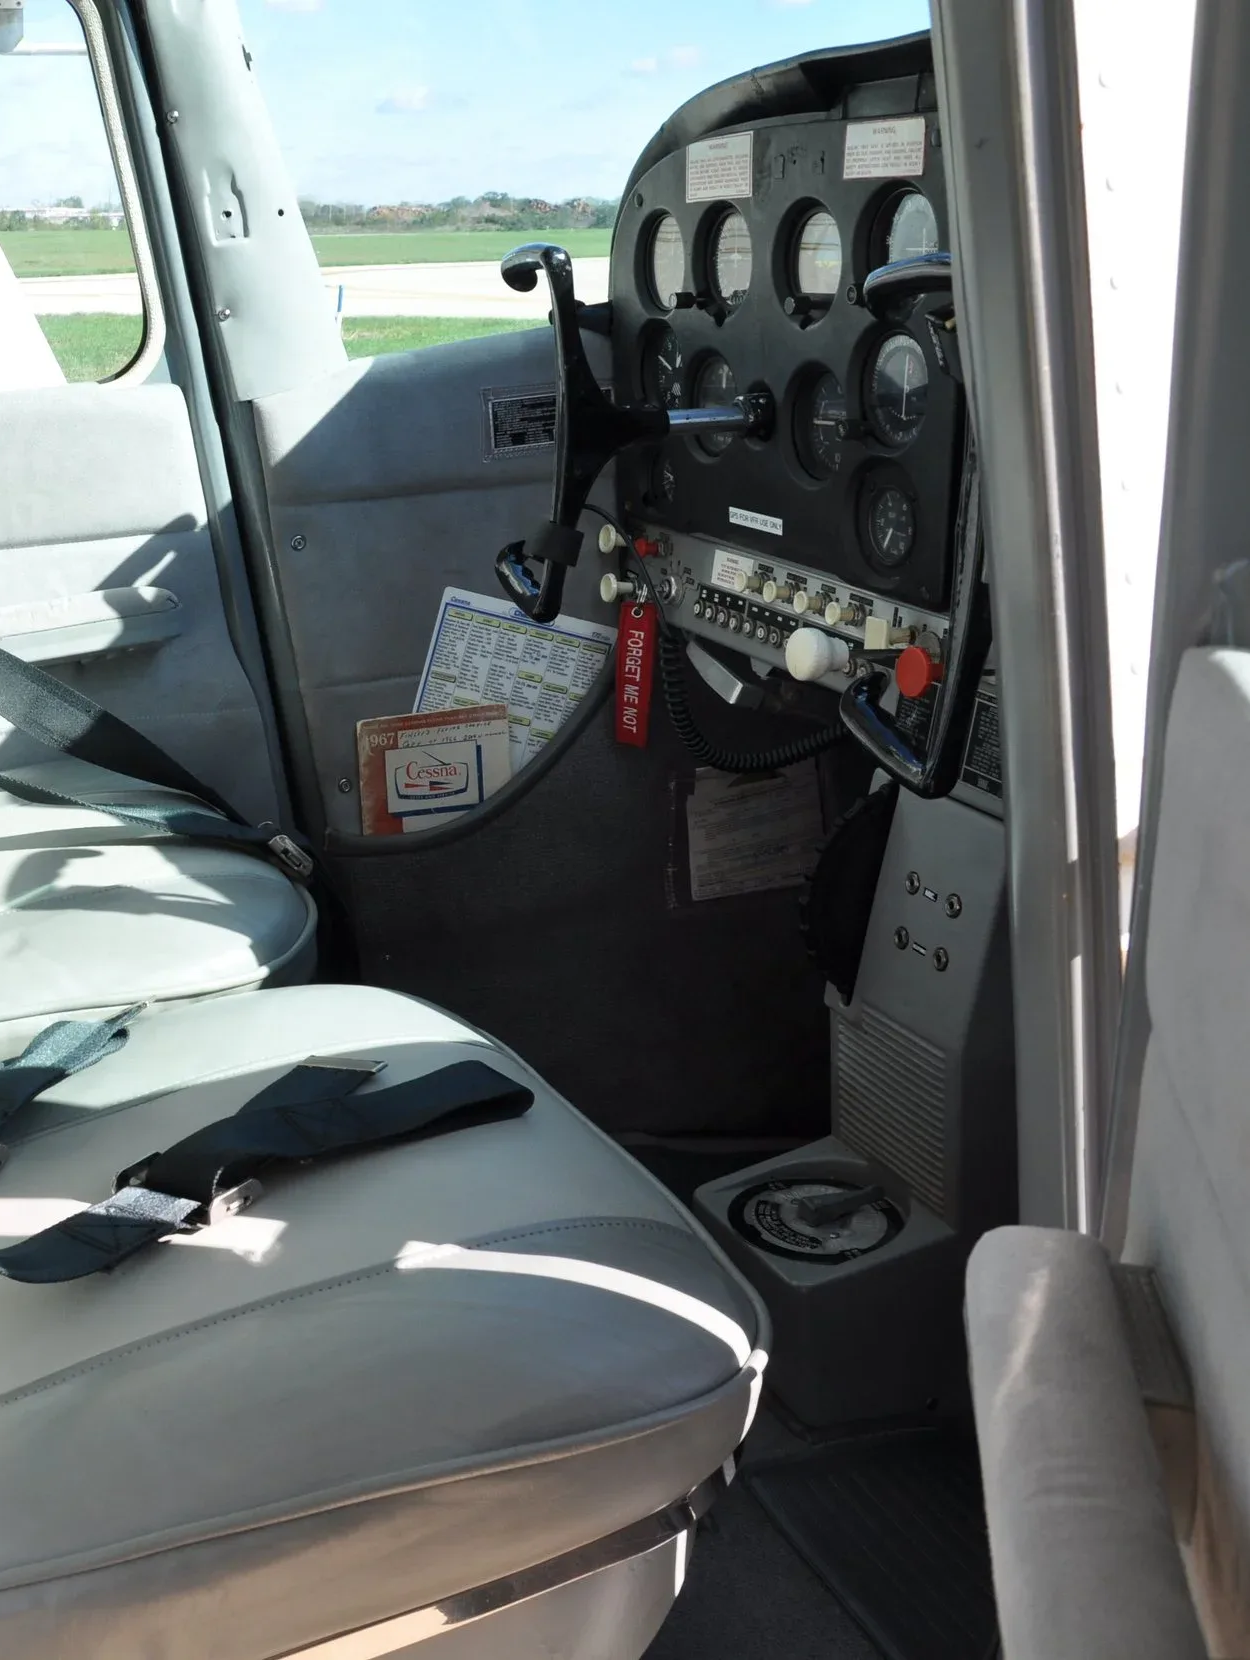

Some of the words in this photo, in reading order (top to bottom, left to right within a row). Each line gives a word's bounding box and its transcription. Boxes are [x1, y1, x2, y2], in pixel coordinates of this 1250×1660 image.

[739, 514, 749, 522] FOR
[769, 522, 782, 530] ONLY
[625, 629, 644, 682] FORGET
[623, 683, 640, 705] ME
[622, 706, 638, 734] NOT
[406, 760, 457, 780] Cessna
